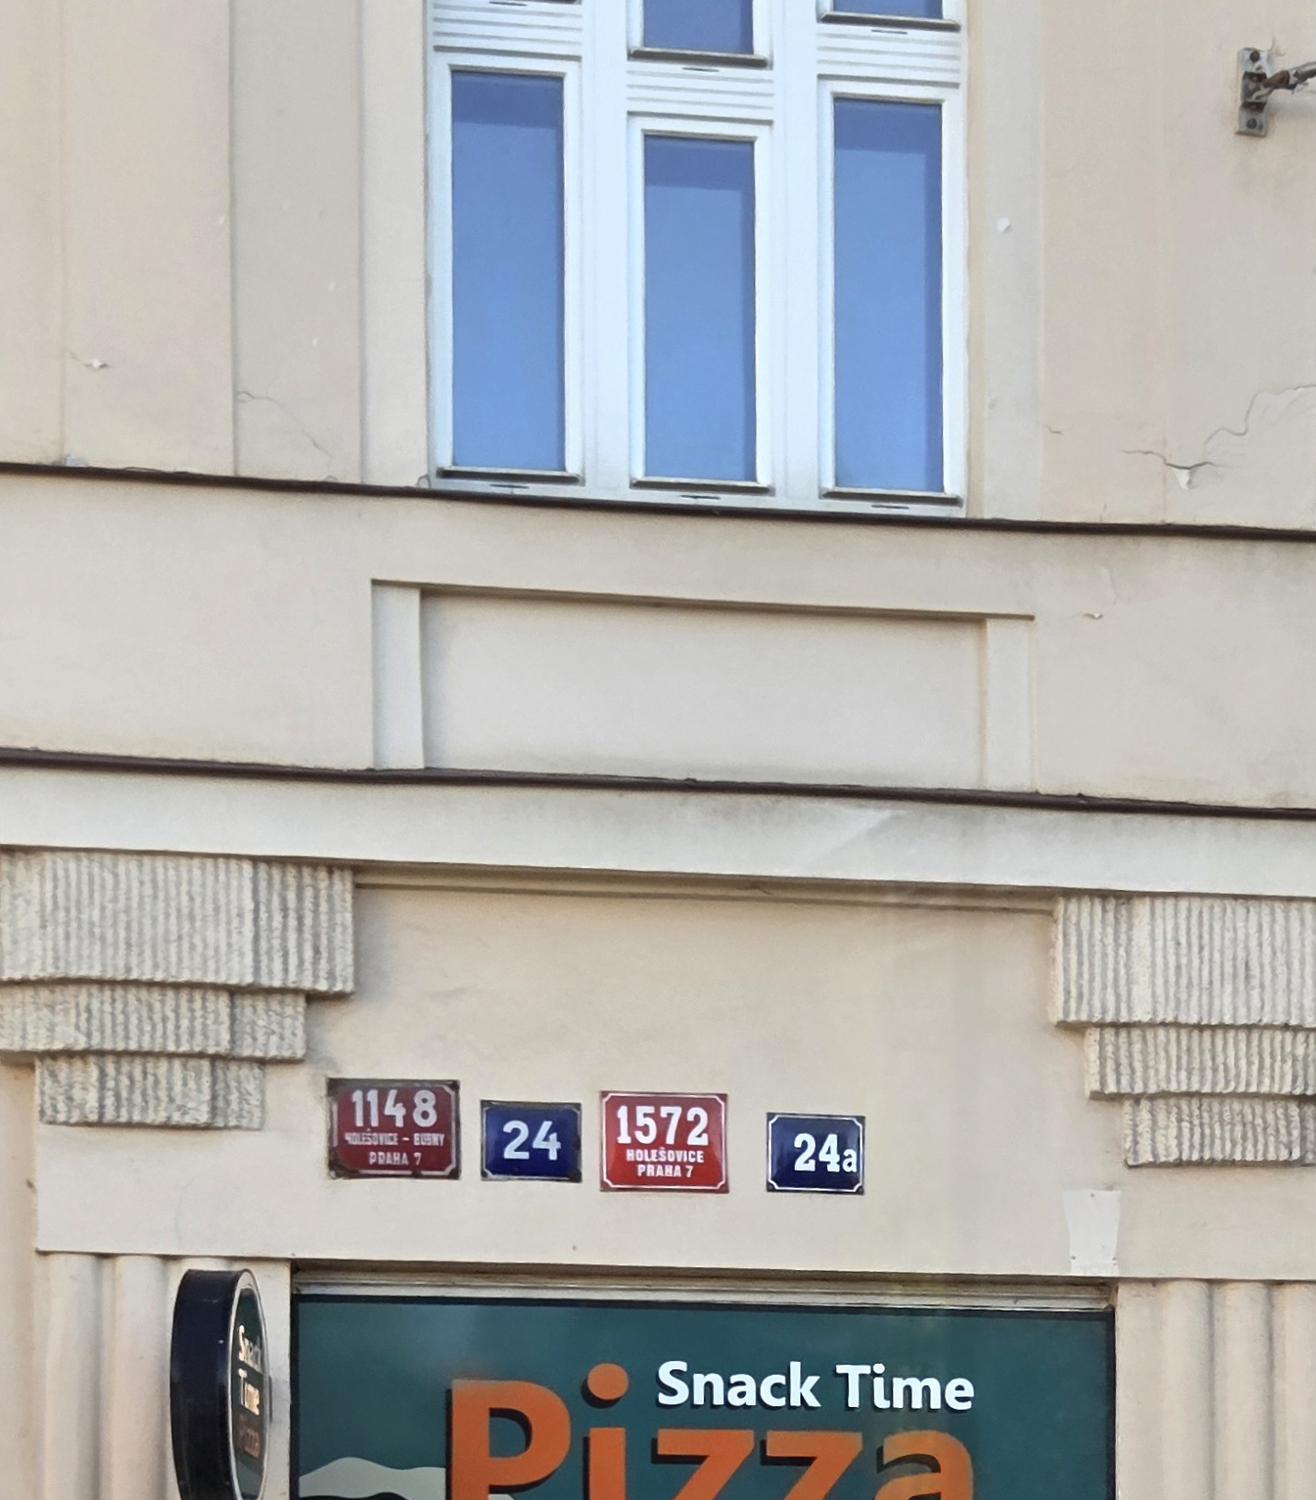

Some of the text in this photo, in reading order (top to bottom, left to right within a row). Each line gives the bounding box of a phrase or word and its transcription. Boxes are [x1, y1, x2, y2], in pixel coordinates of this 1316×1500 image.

[352, 1089, 438, 1128] 1148
[616, 1105, 710, 1146] 1572
[369, 1152, 422, 1166] PRAHA 7
[502, 1120, 562, 1161] 24
[626, 1147, 704, 1163] HOLEŠOVICE
[794, 1133, 858, 1173] 24a
[637, 1164, 694, 1178] PRAHA 7
[657, 1360, 975, 1411] Snack Time
